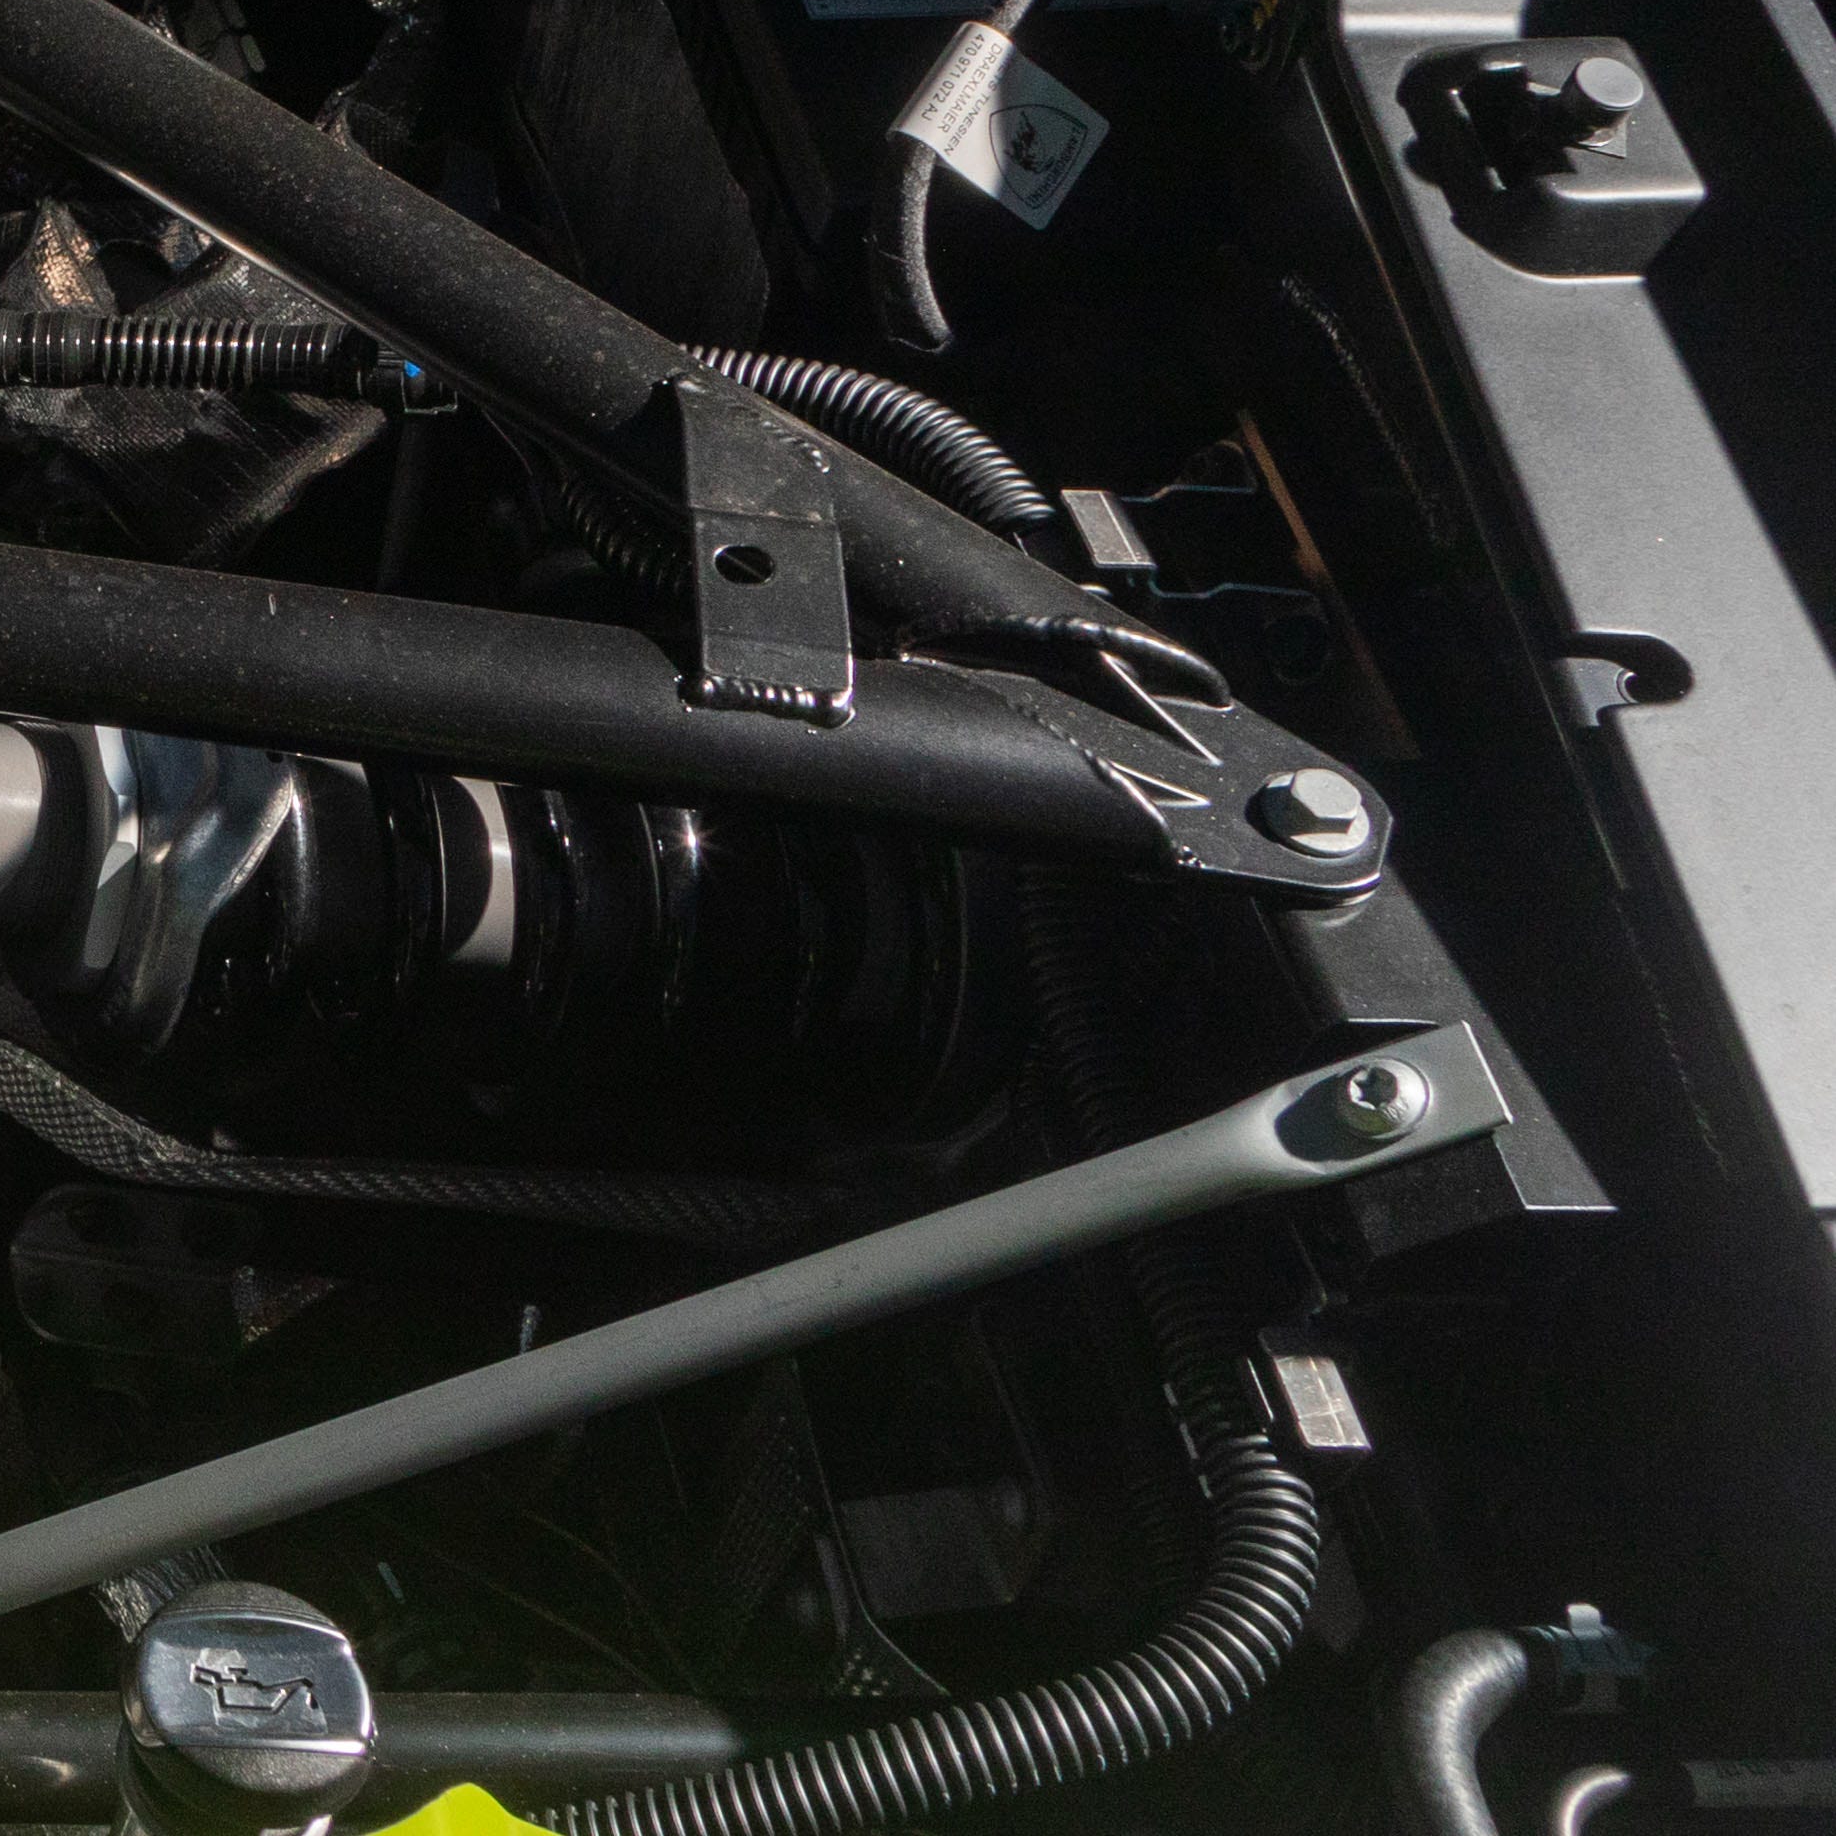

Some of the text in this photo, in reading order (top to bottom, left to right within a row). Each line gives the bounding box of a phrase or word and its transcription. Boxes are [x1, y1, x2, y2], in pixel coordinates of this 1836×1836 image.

[920, 32, 986, 122] 470 971 072 AJ
[936, 42, 1003, 134] DRAEXLMAIER
[942, 92, 991, 157] TUNESIEN
